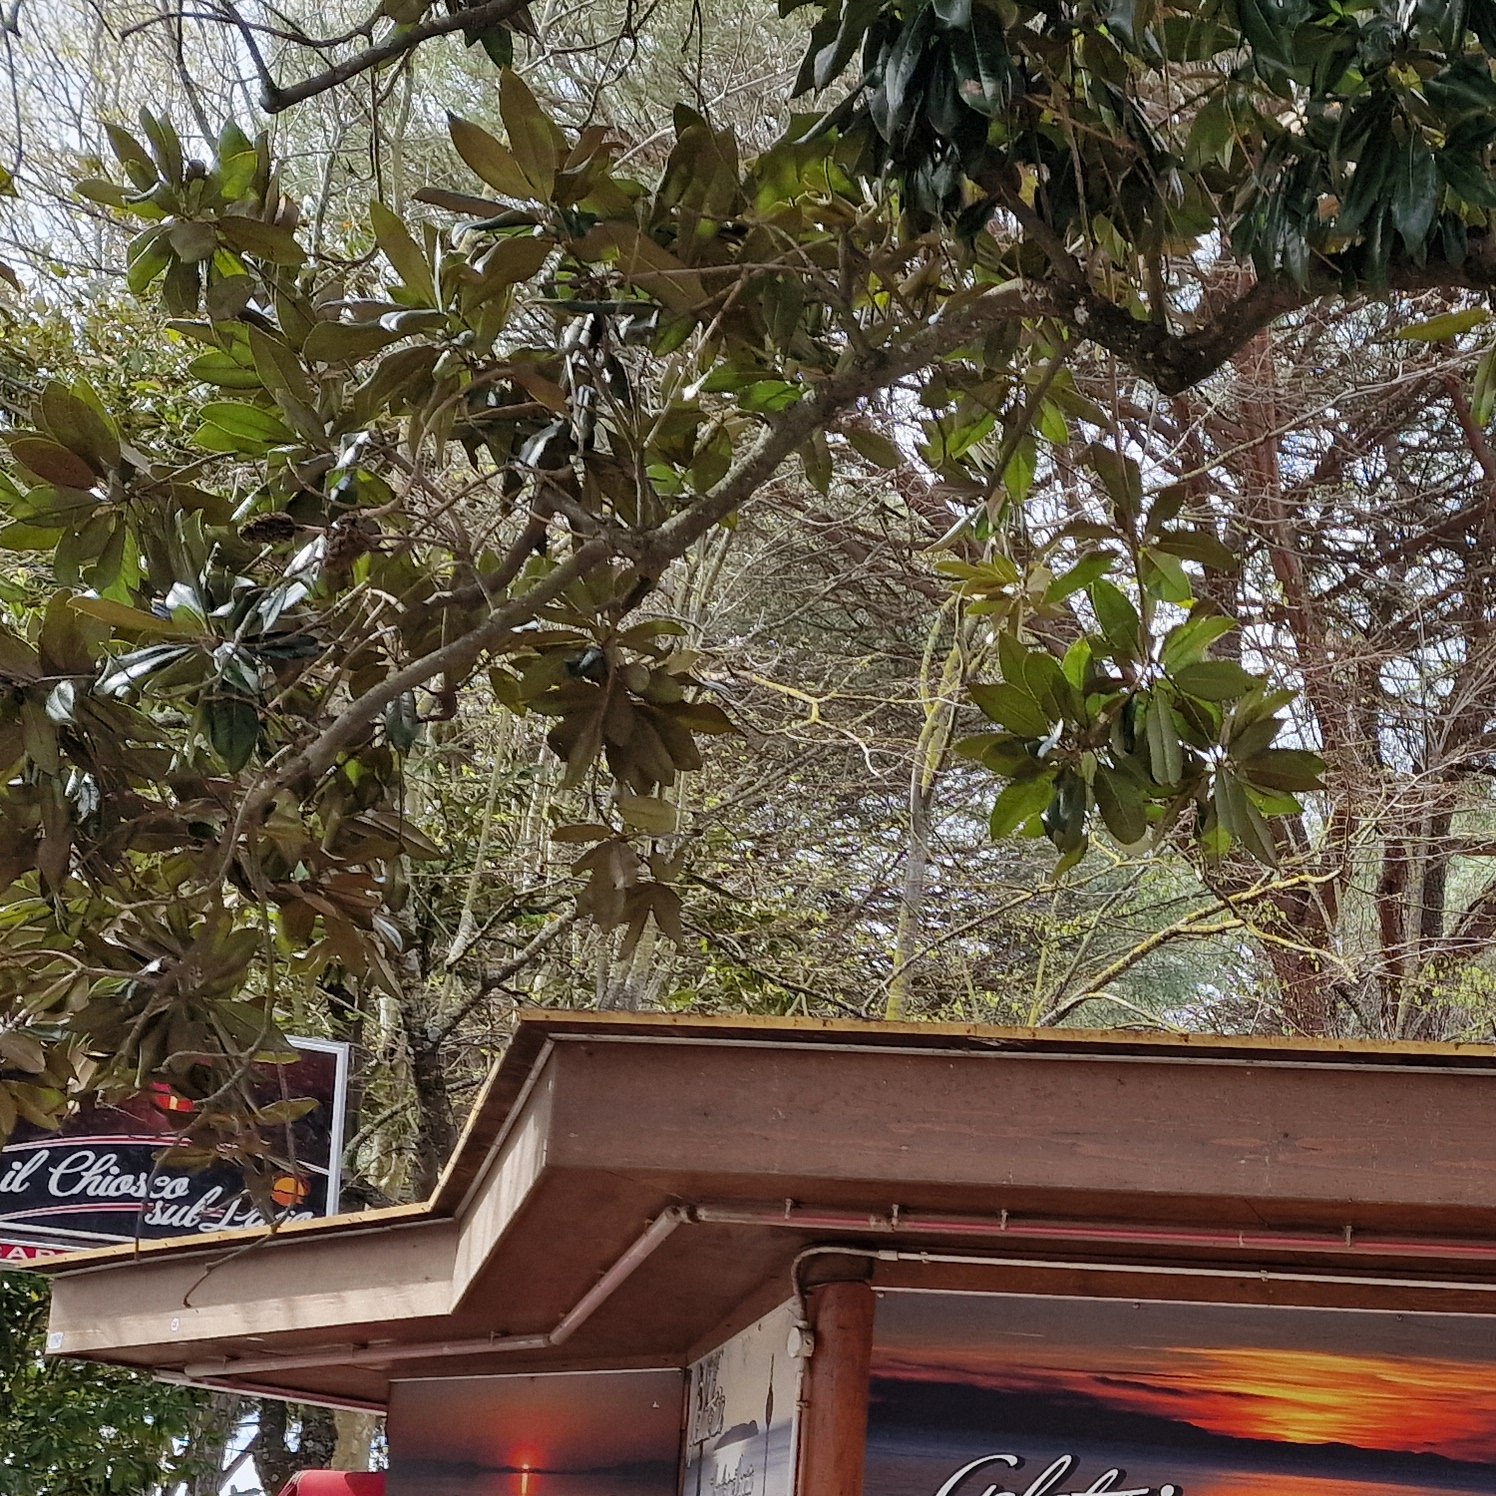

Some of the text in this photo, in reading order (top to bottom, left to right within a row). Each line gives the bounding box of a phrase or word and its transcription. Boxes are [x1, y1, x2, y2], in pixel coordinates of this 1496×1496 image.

[0, 1150, 190, 1199] il Chiosco
[144, 1187, 223, 1230] sul
